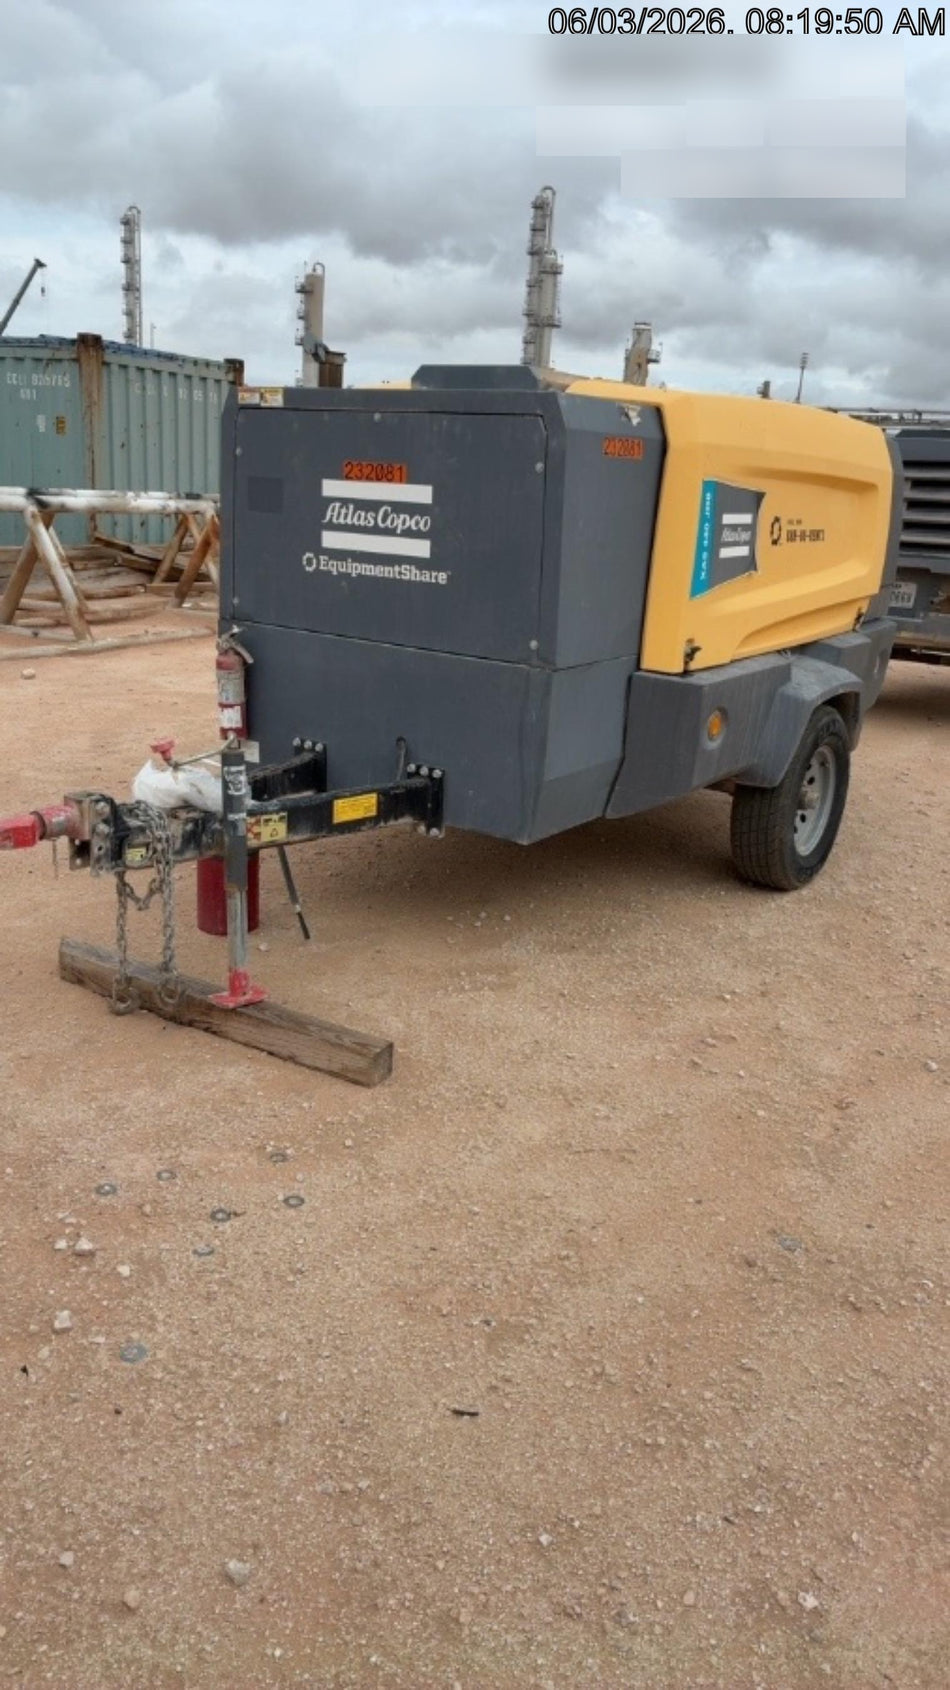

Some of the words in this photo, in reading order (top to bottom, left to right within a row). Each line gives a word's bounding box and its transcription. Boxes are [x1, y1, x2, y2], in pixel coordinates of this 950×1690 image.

[344, 461, 404, 483] 232081
[322, 502, 376, 527] Atlas
[377, 505, 431, 534] Copco
[318, 555, 448, 584] EquipmentShare
